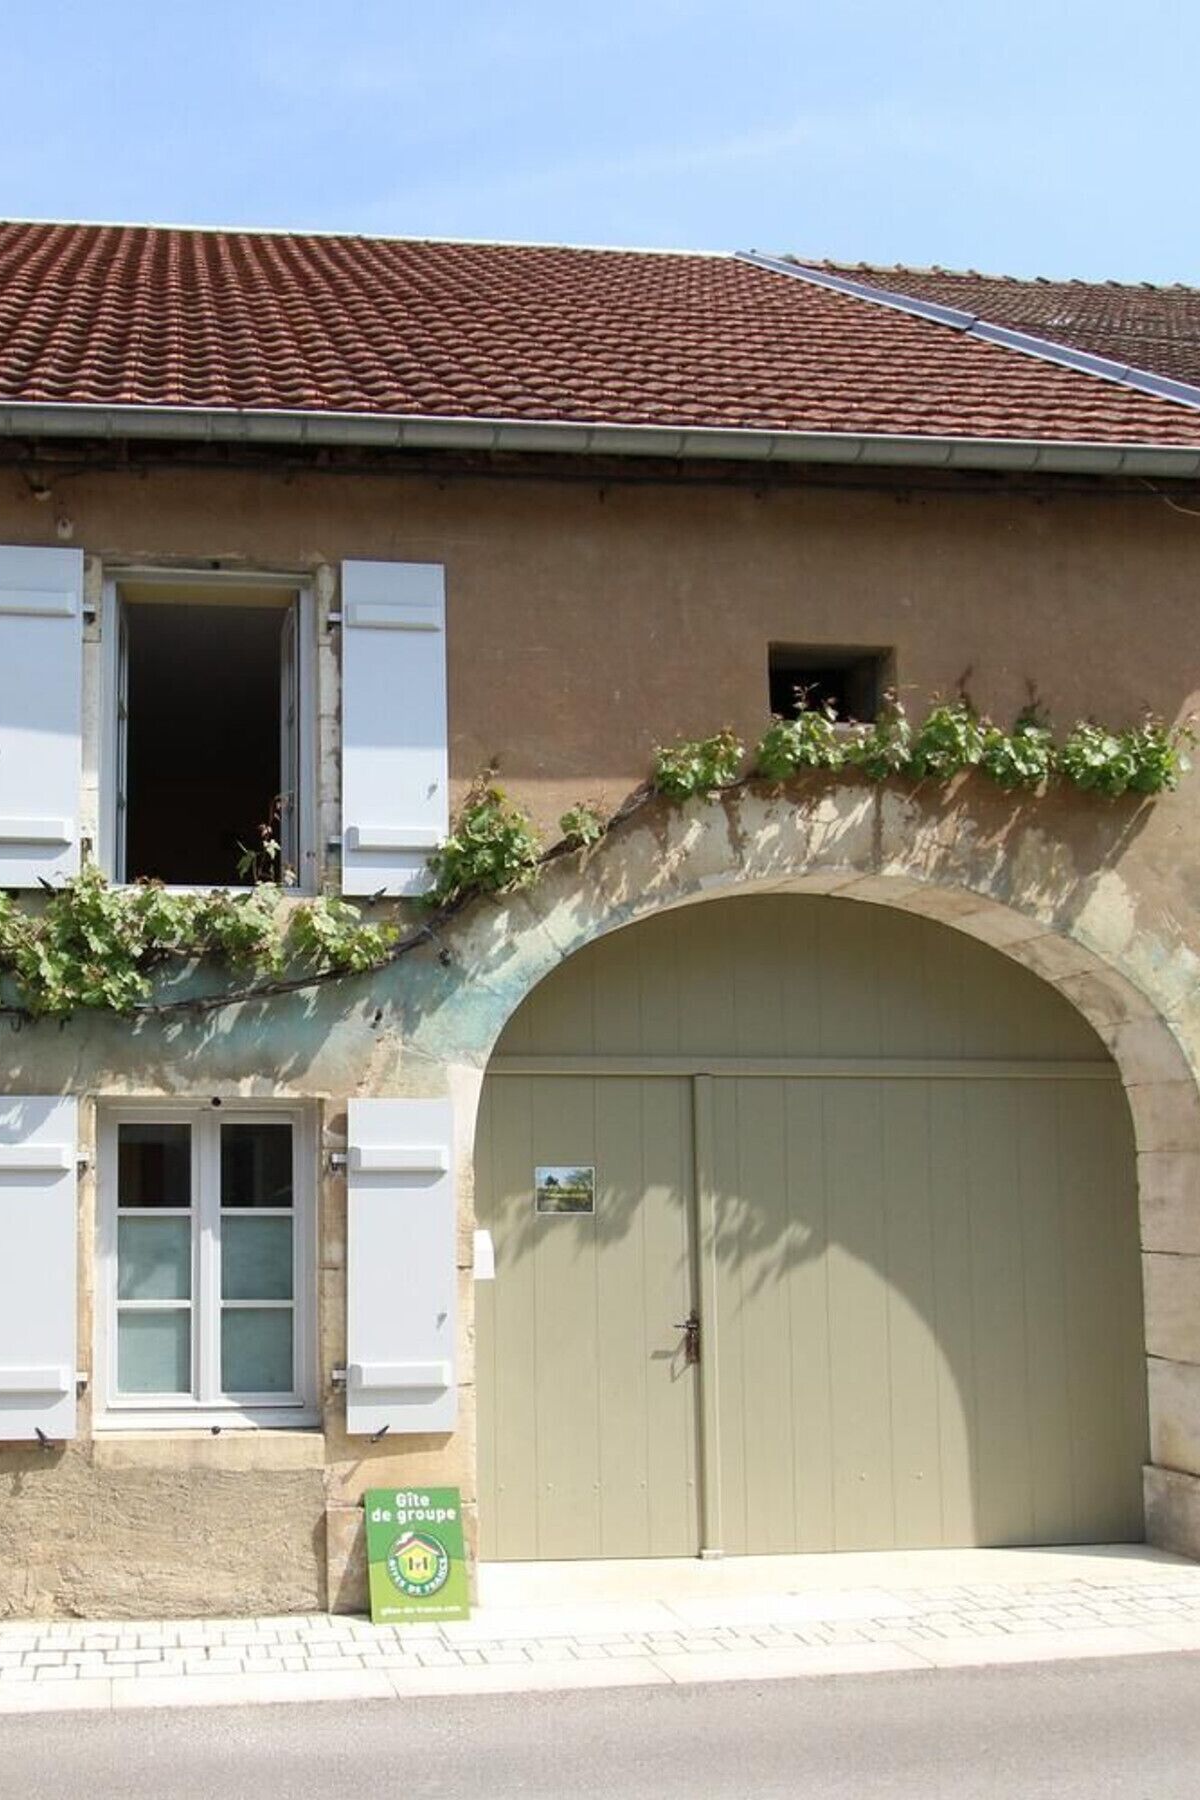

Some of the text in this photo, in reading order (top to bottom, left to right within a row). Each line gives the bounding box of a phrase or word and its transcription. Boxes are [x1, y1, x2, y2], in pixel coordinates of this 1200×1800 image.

[395, 1491, 430, 1508] Gîte
[371, 1507, 457, 1524] de groupe
